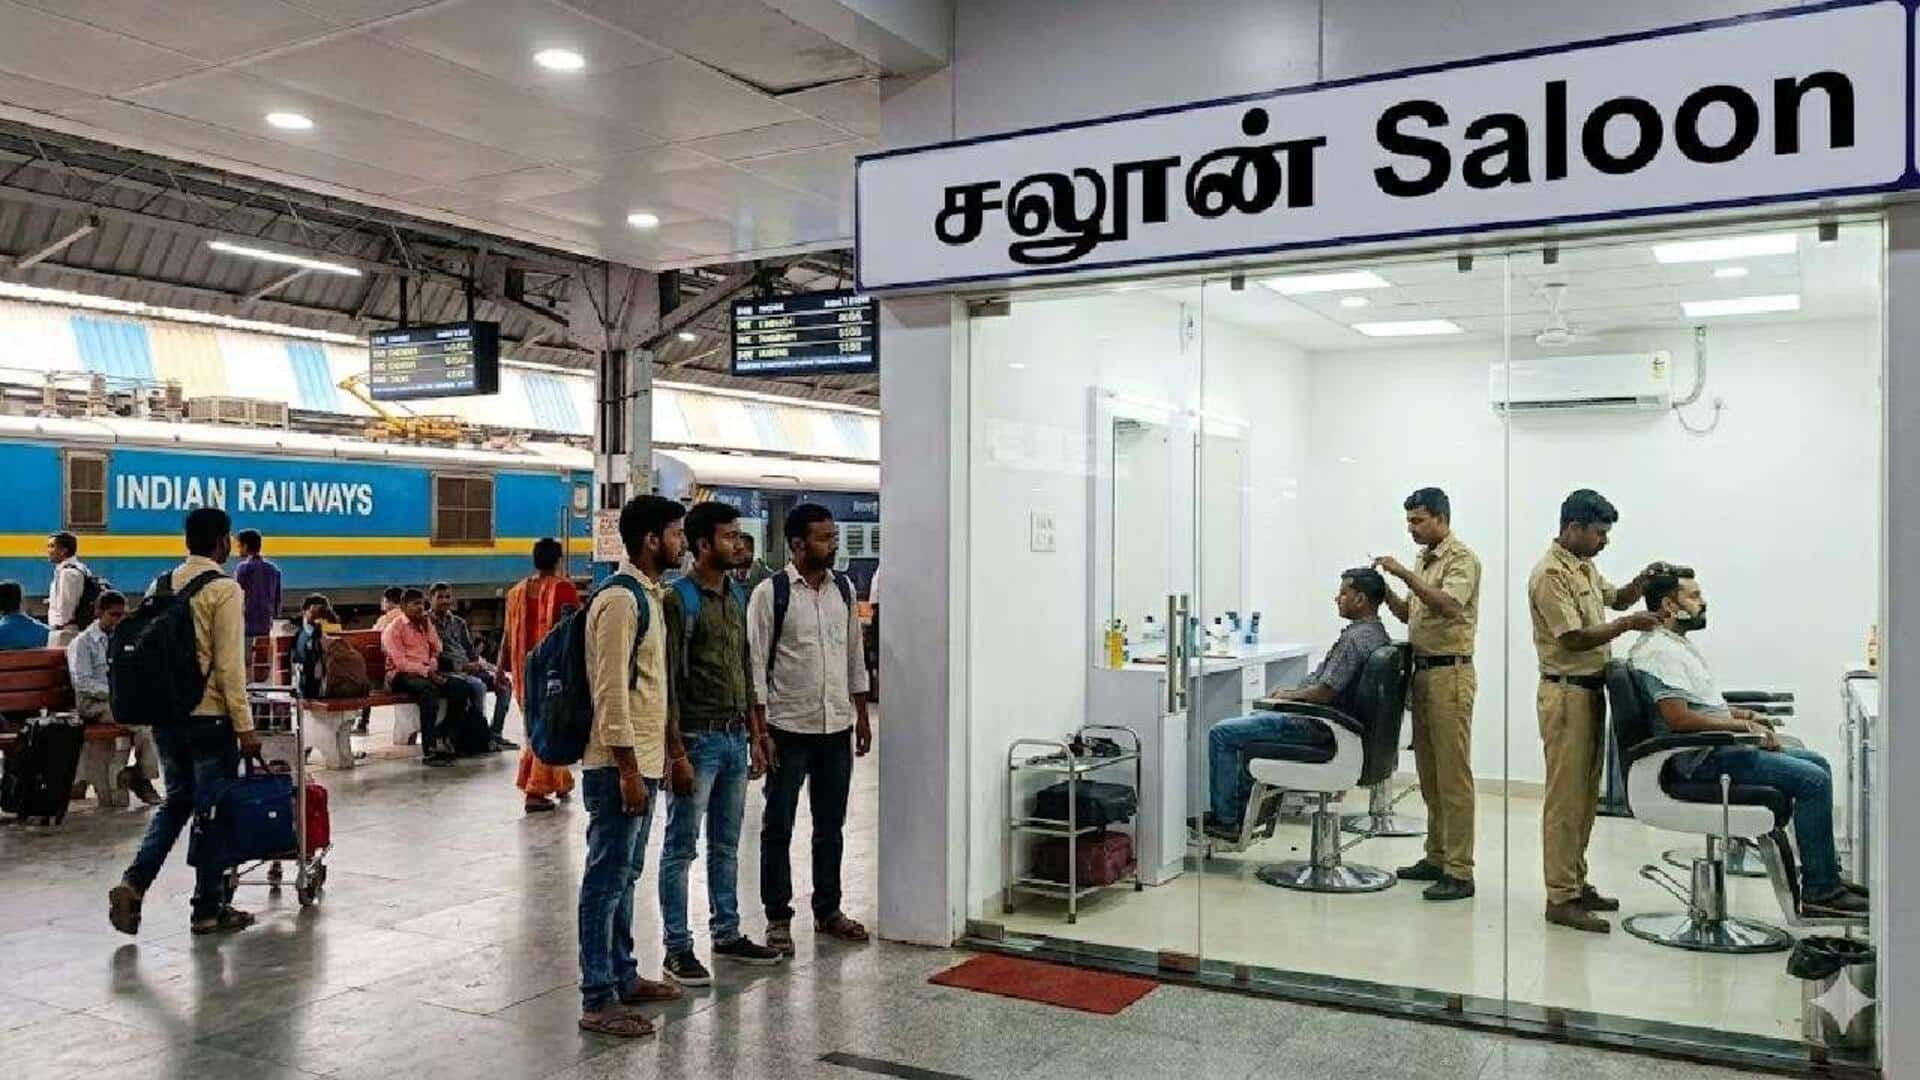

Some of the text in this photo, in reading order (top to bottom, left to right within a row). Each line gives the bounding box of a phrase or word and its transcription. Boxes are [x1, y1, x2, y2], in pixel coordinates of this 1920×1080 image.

[935, 72, 1854, 264] சலூன் Saloon
[116, 474, 373, 515] INDIAN RAILWAYS
